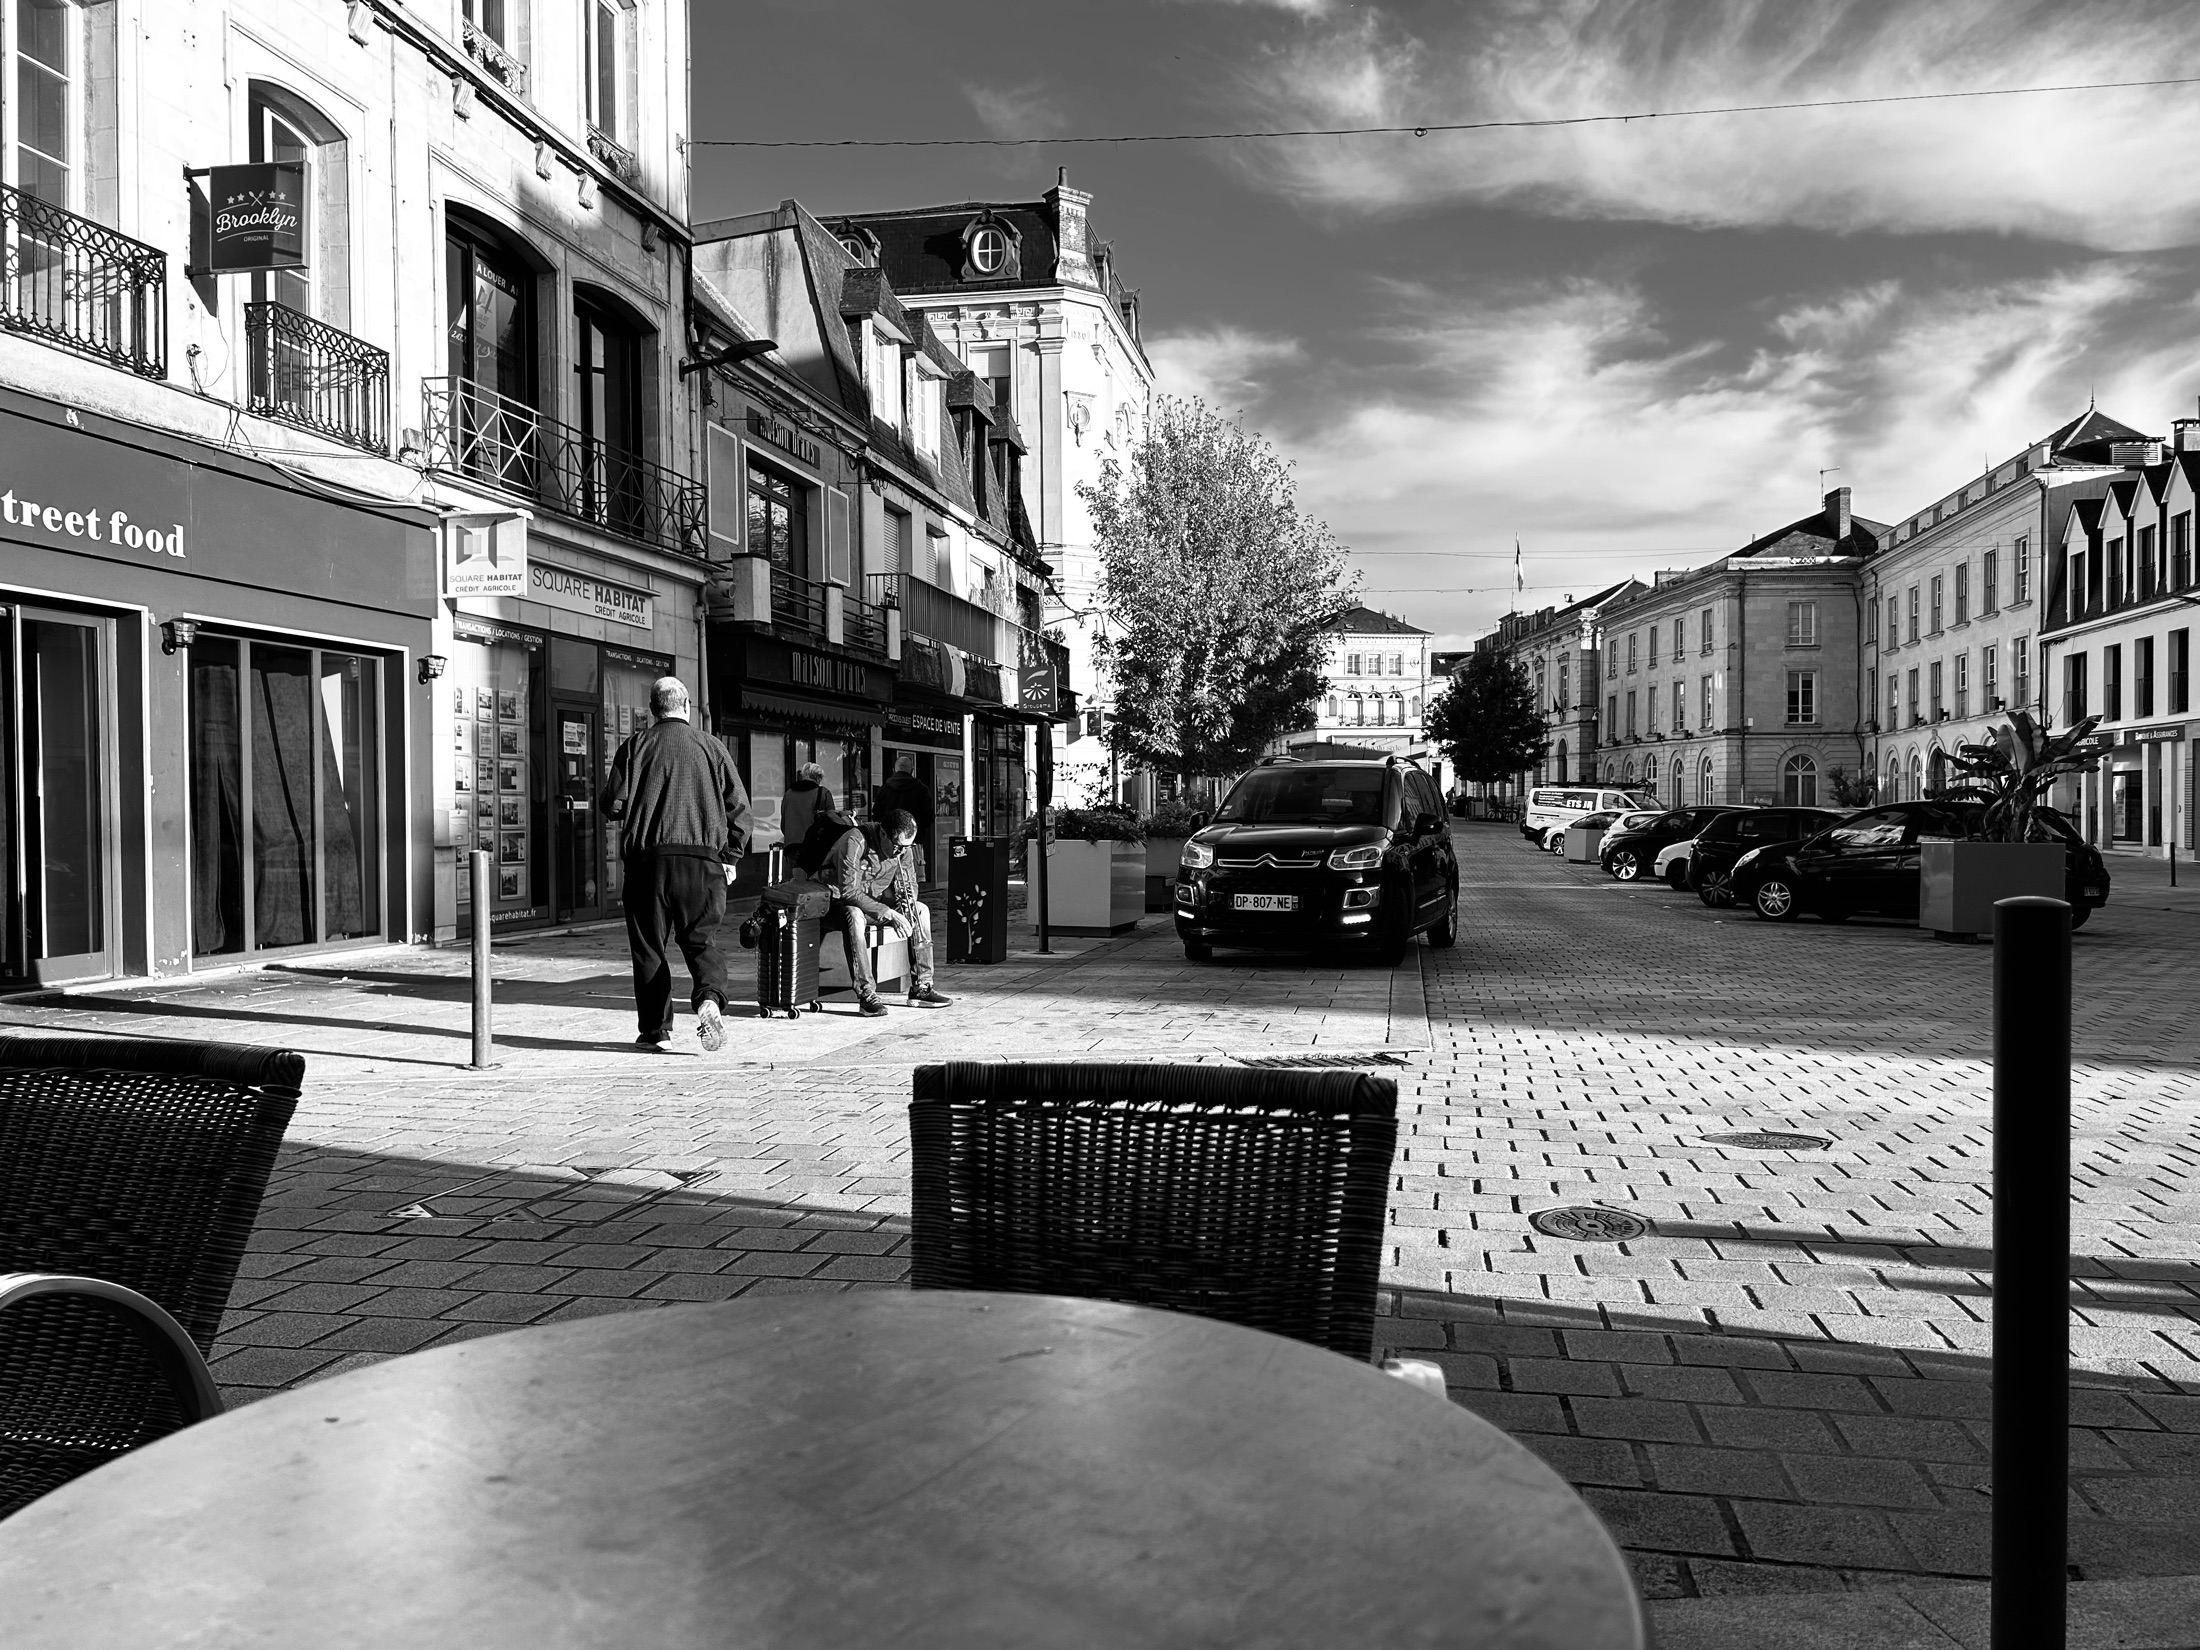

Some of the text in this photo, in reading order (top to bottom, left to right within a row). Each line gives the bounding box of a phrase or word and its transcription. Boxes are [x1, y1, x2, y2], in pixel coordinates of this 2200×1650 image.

[216, 206, 298, 234] Brooklyn
[243, 235, 270, 243] ORIGINAL
[476, 263, 483, 275] A
[483, 266, 507, 289] LOUER
[0, 489, 187, 558] treet food
[449, 573, 523, 583] SQUARE HABITAT
[455, 584, 517, 593] CRÉDIT AGRICOLE
[532, 567, 646, 614] SQUARE HABITAT
[594, 604, 646, 626] CRÉDIT AGRICOLE
[455, 620, 492, 636] TRANSACTIONS
[495, 627, 521, 641] LOCATIONS
[523, 633, 543, 645] GESTION
[912, 713, 961, 736] ESPACE DE VENTE
[1566, 799, 1582, 809] ETS
[1235, 895, 1291, 910] DP-807-NE
